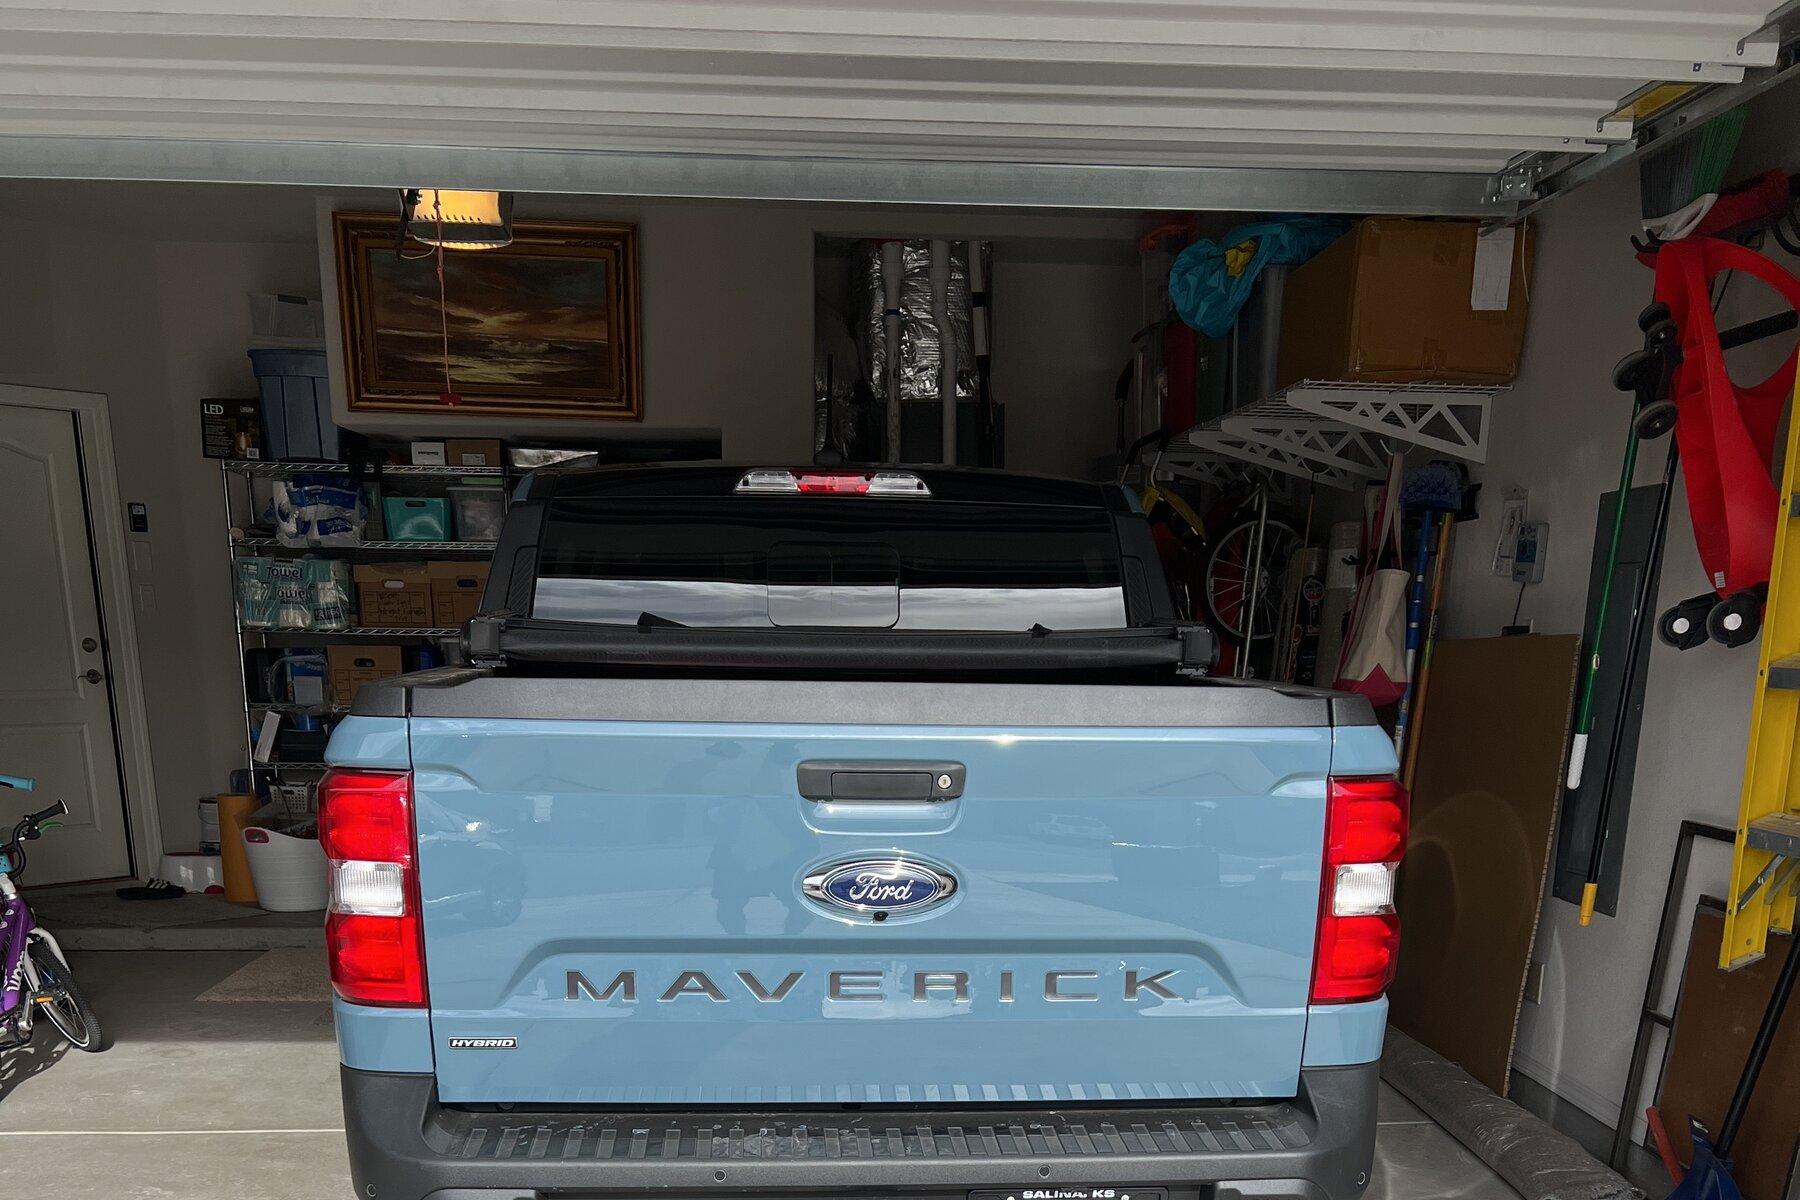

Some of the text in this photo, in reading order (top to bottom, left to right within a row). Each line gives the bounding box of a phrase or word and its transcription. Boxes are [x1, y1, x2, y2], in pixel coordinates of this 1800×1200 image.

[203, 403, 224, 415] LED
[266, 566, 303, 578] Towel
[849, 872, 915, 901] Ford
[564, 969, 1184, 1003] MAVERICK
[451, 1039, 515, 1047] HYBRID
[1092, 1189, 1116, 1199] KS
